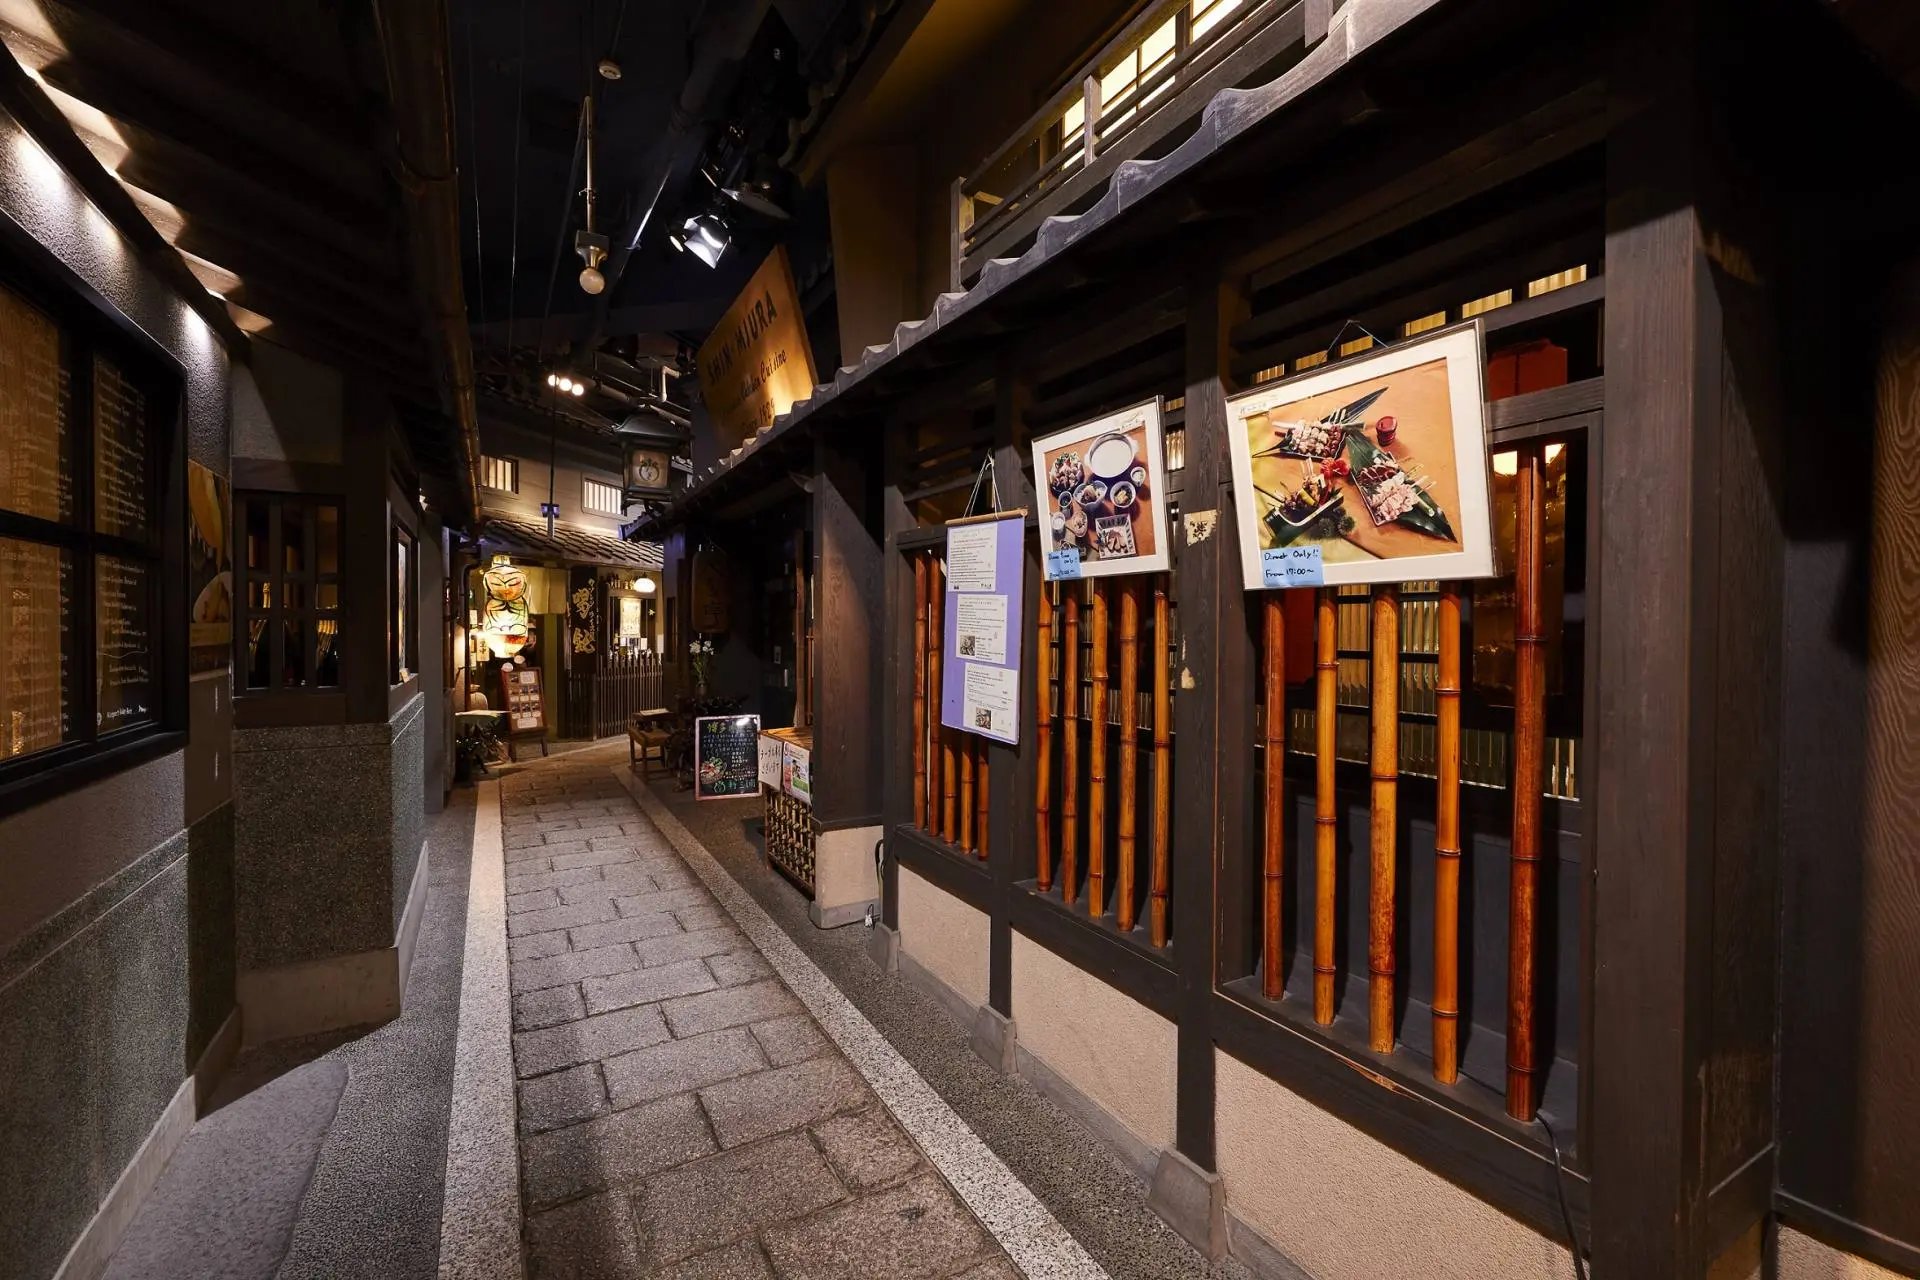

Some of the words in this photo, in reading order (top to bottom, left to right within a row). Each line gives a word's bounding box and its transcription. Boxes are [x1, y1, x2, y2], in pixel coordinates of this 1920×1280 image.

[707, 343, 733, 385] SHIN
[735, 291, 777, 355] MIURA
[760, 349, 787, 383] Cuisine
[1264, 552, 1288, 561] Dinner
[1265, 569, 1284, 579] From
